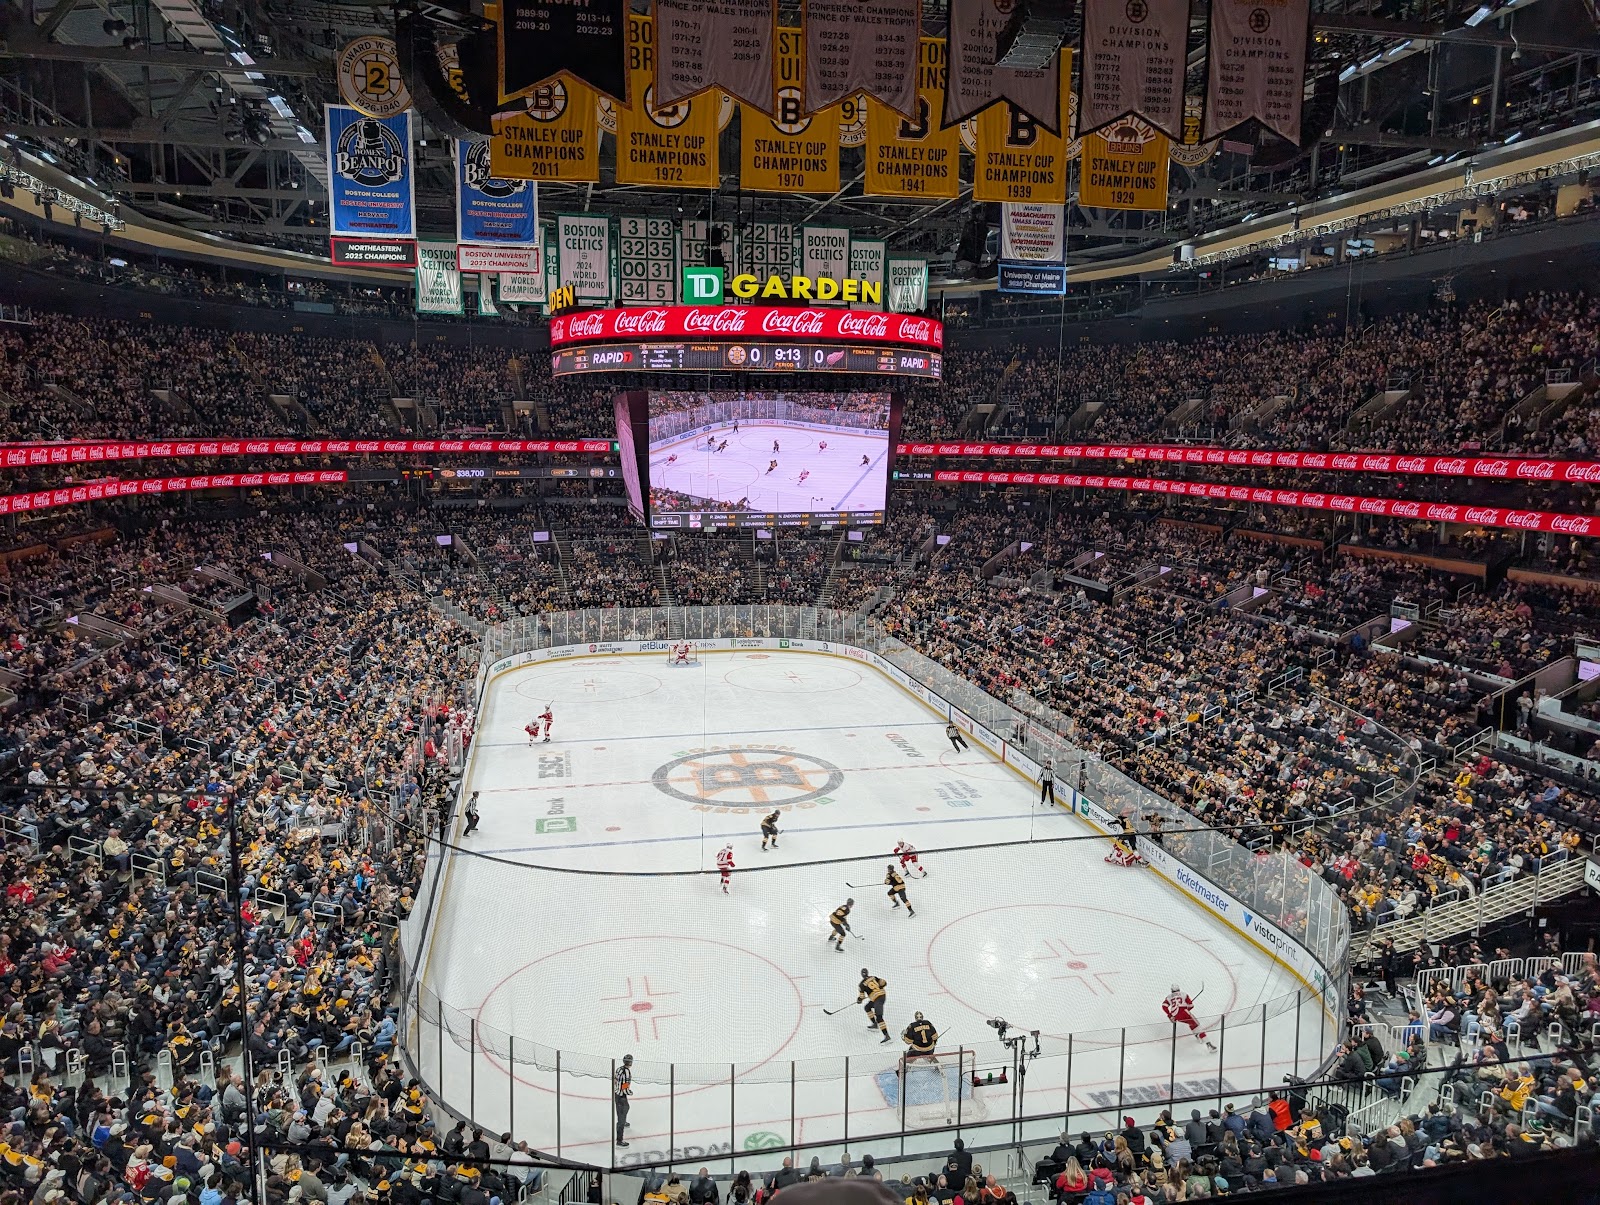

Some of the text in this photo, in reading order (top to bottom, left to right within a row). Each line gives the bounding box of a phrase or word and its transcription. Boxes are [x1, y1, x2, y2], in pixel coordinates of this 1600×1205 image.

[516, 9, 550, 18] 1989-90
[707, 5, 771, 17] WALES TROPHY
[809, 3, 915, 17] CONFERENCE CHAMPIONS
[576, 13, 611, 23] 2013-14
[807, 12, 916, 26] PRINCE OF WALES TROPHY
[516, 21, 550, 31] 2019-20
[576, 25, 613, 36] 2022-23
[1109, 26, 1160, 37] DIVISION
[672, 33, 701, 43] 1971-72
[1102, 39, 1169, 51] CHAMPIONS
[1234, 36, 1281, 46] DIVISION
[342, 41, 372, 74] EDWARD
[1226, 49, 1289, 60] CHAMPIONS
[369, 67, 385, 88] 2
[672, 73, 703, 83] 1989-90
[355, 97, 400, 113] 1926-1940
[842, 101, 855, 119] 9
[505, 126, 583, 143] STANLEY CUP
[1184, 125, 1200, 137] 77
[631, 132, 705, 149] STANLEY CUP
[755, 139, 827, 156] STANLEY CUP
[505, 143, 585, 160] CHAMPIONS
[879, 146, 948, 161] STANLEY CUP
[1110, 143, 1140, 153] BRUINS
[1170, 147, 1208, 161] 1979-2000
[335, 151, 406, 177] BEANPOT
[630, 149, 706, 166] CHAMPIONS
[754, 156, 827, 172] CHAMPIONS
[988, 153, 1054, 168] STANLEY CUP
[532, 162, 559, 176] 2011
[878, 162, 948, 177] CHAMPIONS
[1092, 158, 1156, 174] STANLEY CUP
[655, 167, 683, 181] 1972
[778, 173, 804, 187] 1970
[986, 168, 1054, 184] CHAMPIONS
[901, 179, 925, 191] 1941
[1091, 174, 1156, 189] CHAMPIONS
[1007, 185, 1032, 198] 1939
[1111, 191, 1135, 204] 1929
[1010, 211, 1056, 219] MASSACHUSETTS
[564, 225, 605, 237] BOSTON
[628, 220, 638, 235] 3
[649, 221, 672, 237] 33
[771, 226, 789, 241] 14
[348, 244, 402, 252] NORTHEASTERN
[565, 238, 603, 251] CELTICS
[623, 240, 645, 256] 32
[808, 236, 845, 247] BOSTON
[421, 249, 456, 260] BOSTON
[494, 252, 531, 260] UNIVERSITY
[649, 241, 672, 257] 35
[686, 243, 704, 258] 19
[744, 245, 765, 260] 23
[771, 246, 789, 261] 15
[809, 249, 843, 260] CELTICS
[364, 253, 407, 261] CHAMPIONS
[423, 260, 456, 271] CELTICS
[623, 262, 645, 277] 00
[652, 263, 670, 277] 31
[892, 267, 923, 276] BOSTON
[511, 276, 535, 285] WORLD
[573, 271, 597, 279] WORLD
[893, 277, 921, 286] CELTICS
[1004, 271, 1033, 280] University
[1041, 273, 1060, 281] Maine
[503, 285, 543, 295] CHAMPIONS
[565, 280, 604, 289] CHAMPIONS
[624, 282, 645, 298] 34
[656, 284, 666, 298] 5
[687, 274, 880, 304] TD GARDEN
[1025, 281, 1056, 289] Champions
[550, 285, 574, 312] DEN
[570, 314, 604, 337] Coca-Cola
[615, 310, 668, 333] Coca-Cola
[684, 309, 748, 332] Coca-Cola
[763, 310, 826, 333] Coca-Cola
[838, 313, 888, 336] Coca-Cola
[899, 318, 930, 341] Coca-Cola
[750, 348, 761, 361] 0
[775, 348, 801, 361] 9:13
[815, 350, 824, 363] 0
[457, 469, 484, 477] $38,700
[639, 641, 668, 651] jetBlue
[1176, 867, 1229, 912] ticketmaster
